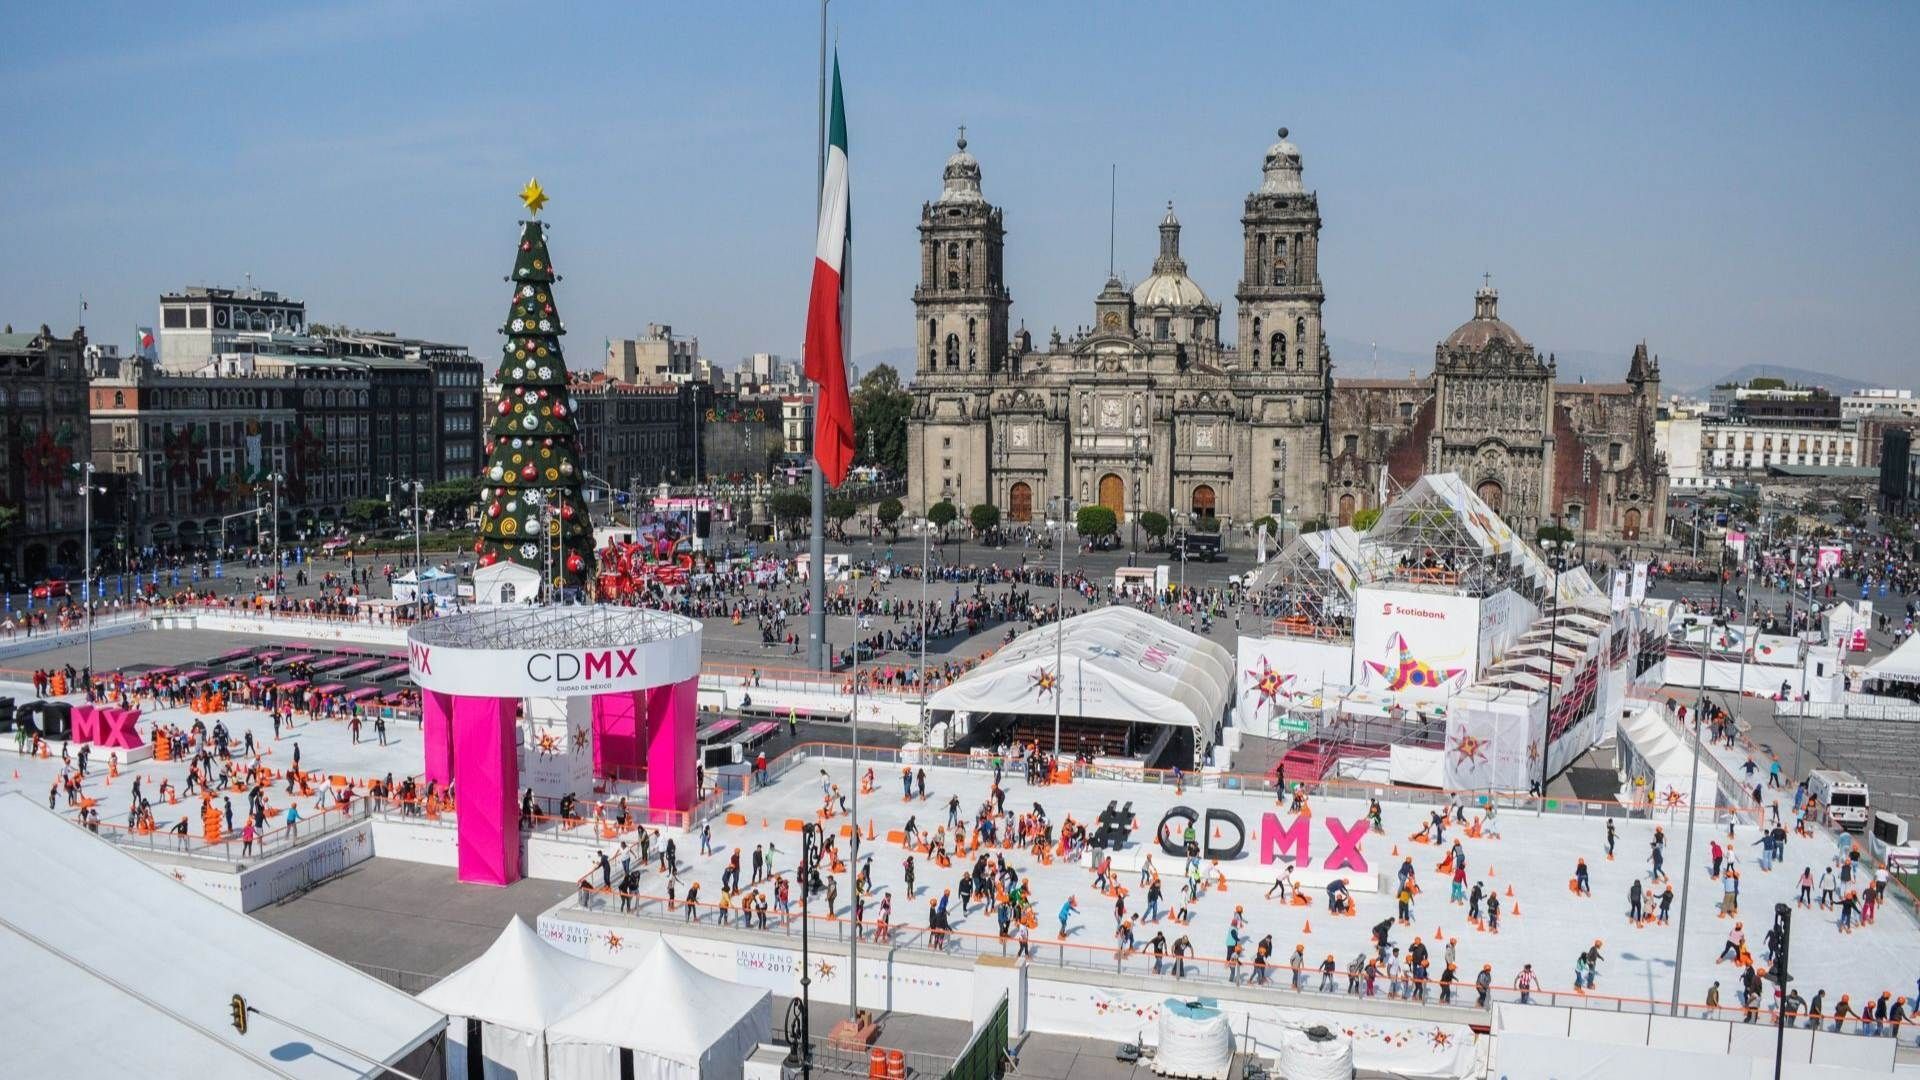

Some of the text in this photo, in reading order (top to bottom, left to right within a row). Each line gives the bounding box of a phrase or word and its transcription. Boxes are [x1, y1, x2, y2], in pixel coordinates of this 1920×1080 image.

[1396, 606, 1446, 619] Scotiabank
[527, 648, 637, 682] CDMX
[538, 919, 589, 935] INVIERNO
[537, 927, 588, 944] CDMX 2017
[736, 957, 791, 973] CDMX 2017
[737, 950, 792, 964] INVIERNO
